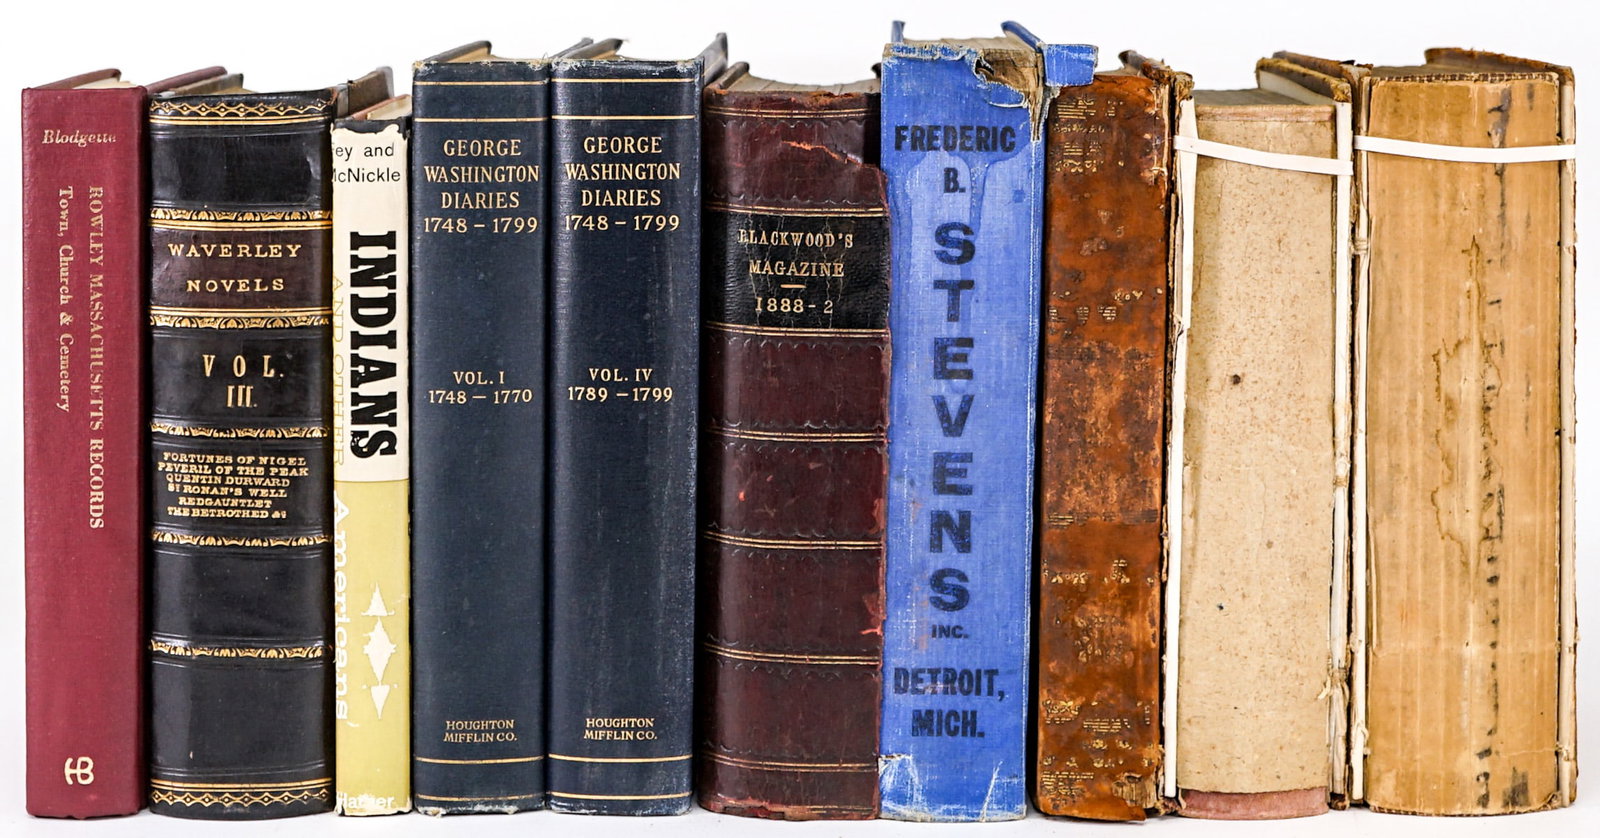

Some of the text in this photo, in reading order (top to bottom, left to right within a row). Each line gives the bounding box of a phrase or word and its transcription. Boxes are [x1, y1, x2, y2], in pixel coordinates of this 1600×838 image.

[583, 136, 663, 154] GEORGE
[895, 125, 1016, 151] FREDERIC
[331, 142, 395, 162] ey and
[443, 139, 522, 156] GEORGE
[424, 165, 540, 183] WASHINGTON
[564, 162, 681, 180] WASHINGTON
[944, 167, 966, 194] B.
[441, 191, 520, 209] DIARIES
[581, 189, 661, 207] DIARIES
[423, 217, 468, 233] 1748
[493, 217, 538, 233] 1799
[564, 215, 610, 232] 1748
[634, 215, 680, 231] 1799
[738, 229, 853, 248] BLACKWOOD'S
[168, 243, 301, 258] WAVERLEY
[750, 260, 844, 277] MAGAZINE
[186, 278, 285, 293] NOVELS
[55, 186, 74, 413] Town, Church & Cemetery
[350, 230, 398, 459] INDIANS
[89, 186, 104, 529] ROWLEY MASSACHUSETTS RECORDS
[202, 354, 284, 378] VOL.
[333, 273, 344, 466] AND OTHER
[453, 371, 505, 385] VOL. I
[588, 368, 653, 381] VOL. IV
[226, 385, 258, 408] III.
[428, 390, 467, 404] 1748
[494, 389, 533, 404] 1770
[567, 386, 608, 402] 1789
[929, 222, 975, 612] STEVENS
[163, 451, 307, 466] FORTUNES OF NIGEL
[157, 461, 309, 477] PEVERIL OF THE PEAK
[166, 473, 290, 488] QUENTIN DURWARD
[183, 484, 243, 497] RONAN'S
[248, 487, 288, 498] WELL
[178, 496, 273, 509] REDGAUNTLET
[167, 506, 190, 517] THE
[191, 508, 269, 519] BETROTHED
[334, 490, 351, 720] Americans
[931, 624, 969, 639] INC.
[894, 667, 1005, 702] DETROIT,
[445, 719, 514, 730] HOUGHTON
[586, 717, 654, 728] HOUGHTON
[911, 709, 985, 738] MICH.
[443, 732, 517, 743] MIFFLIN CO.
[583, 730, 658, 741] MIFFLIN CO.
